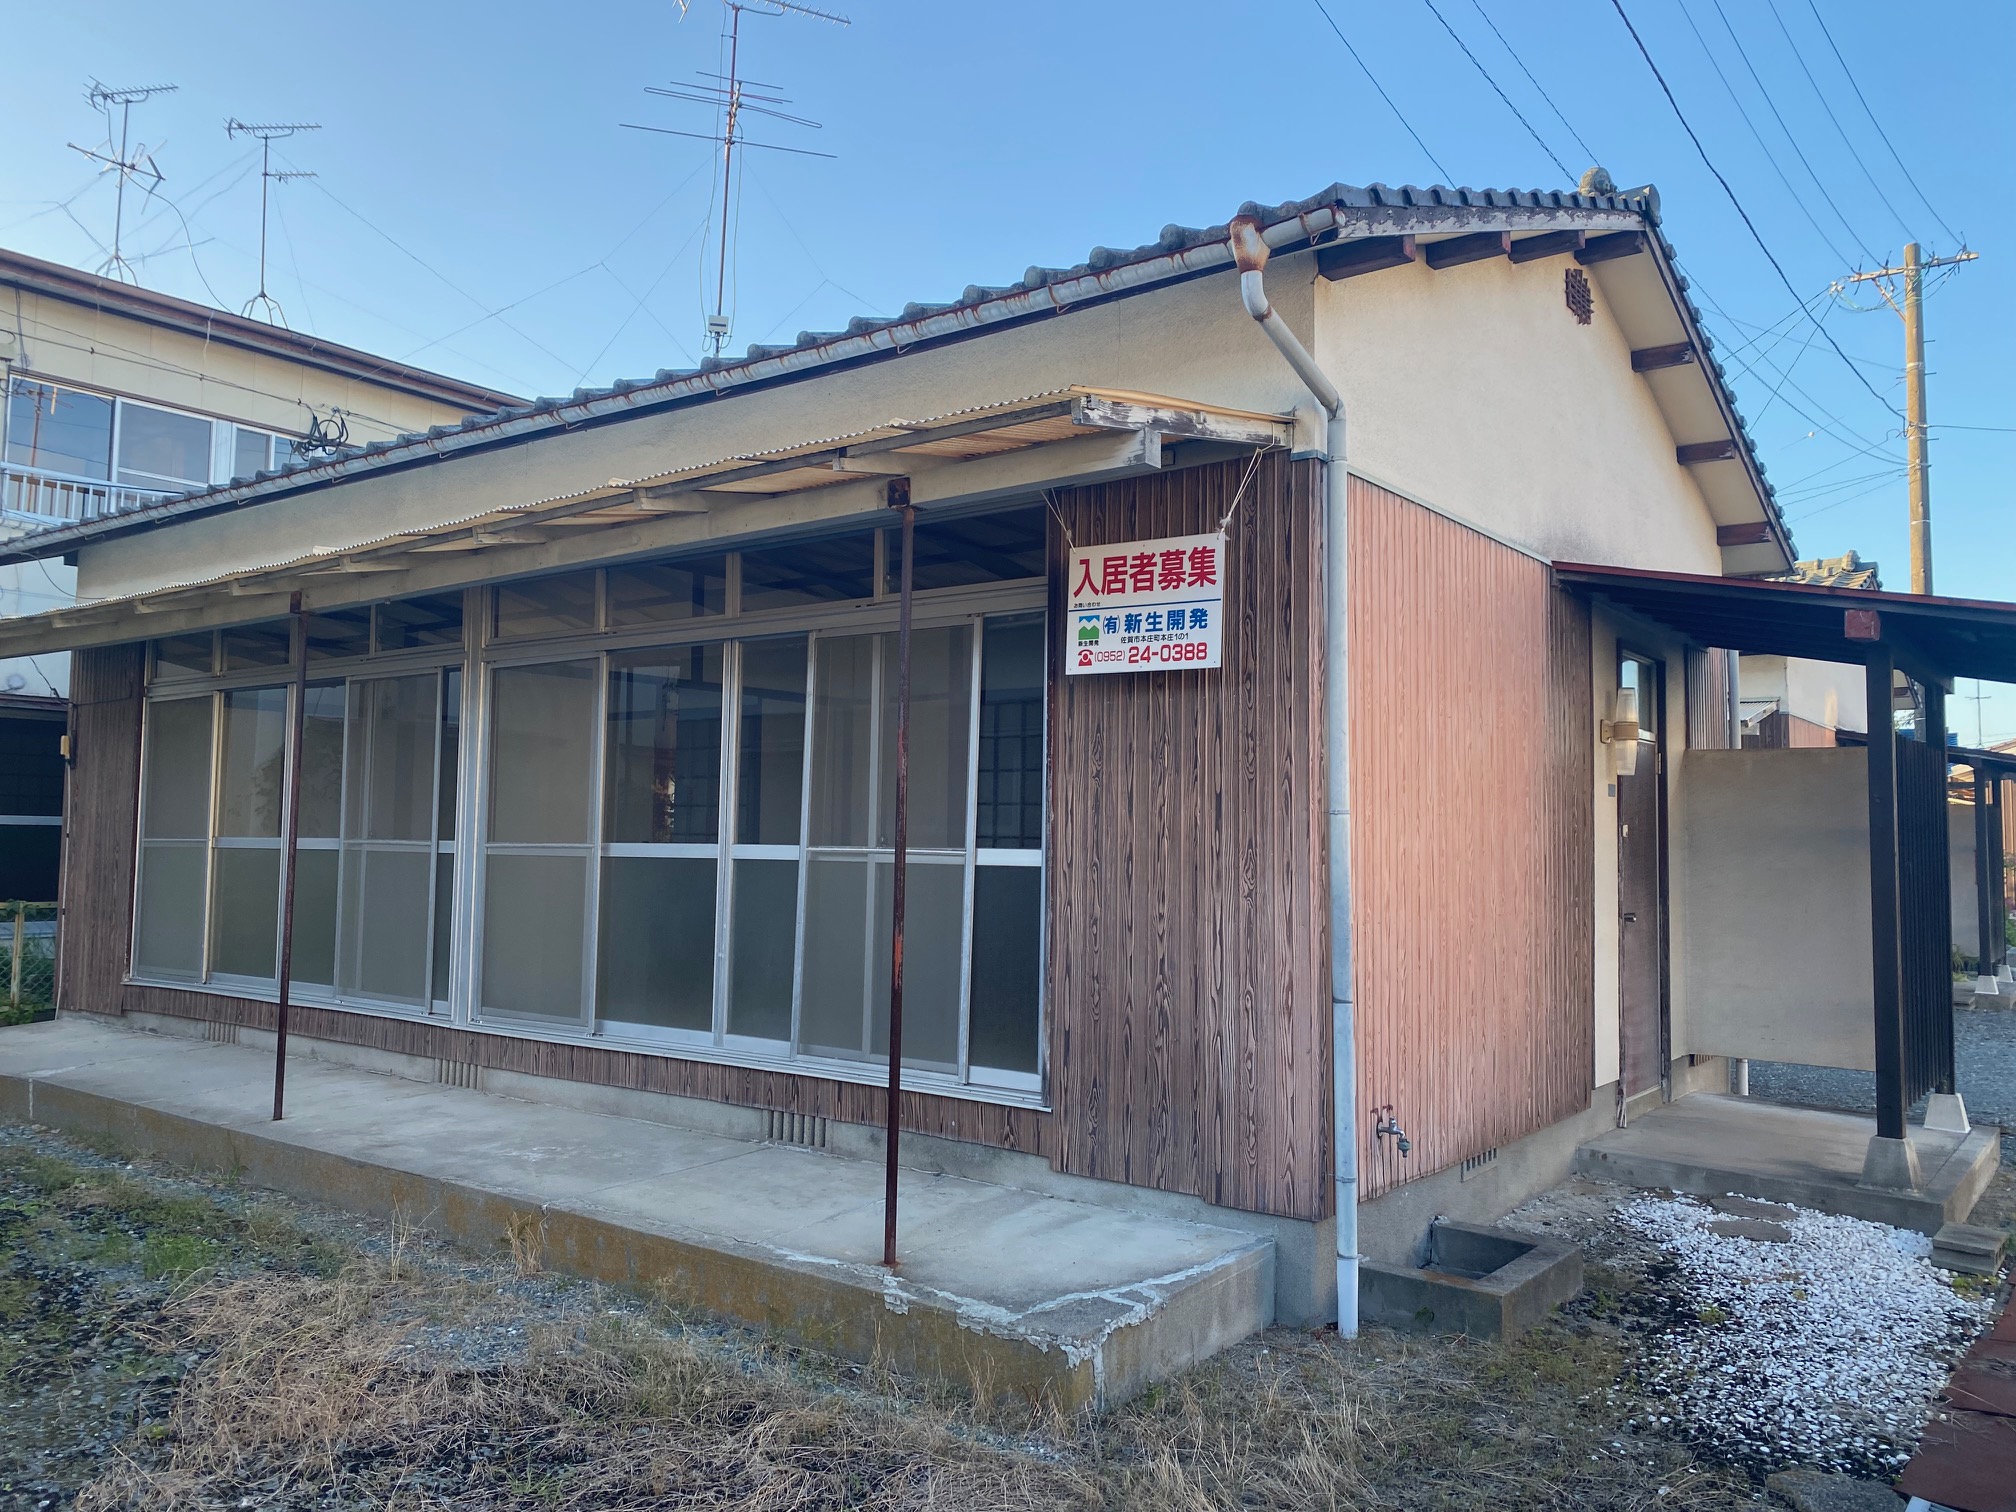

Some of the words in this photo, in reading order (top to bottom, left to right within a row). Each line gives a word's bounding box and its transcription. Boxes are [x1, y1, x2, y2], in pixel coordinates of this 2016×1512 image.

[1073, 546, 1217, 598] 入居者募集
[1128, 642, 1208, 664] 24-0388
